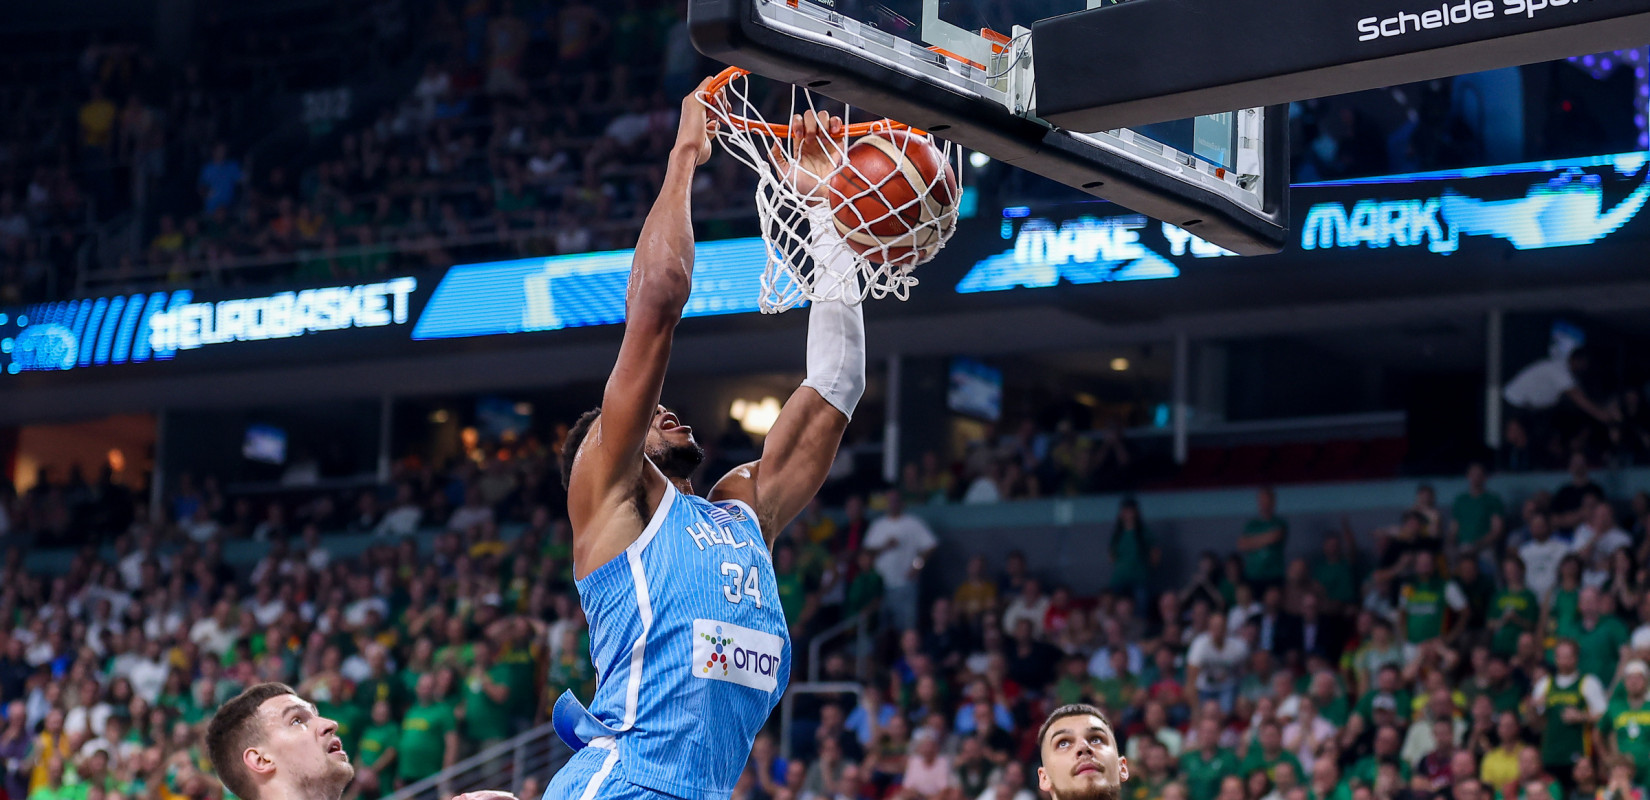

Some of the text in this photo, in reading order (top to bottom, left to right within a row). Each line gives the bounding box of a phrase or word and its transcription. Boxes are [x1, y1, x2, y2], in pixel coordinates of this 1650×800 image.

[1357, 0, 1494, 42] Schelde
[1014, 216, 1146, 264] MAKE
[1301, 198, 1444, 250] MARK
[150, 277, 417, 351] #EUROBASKET
[721, 561, 761, 609] 34
